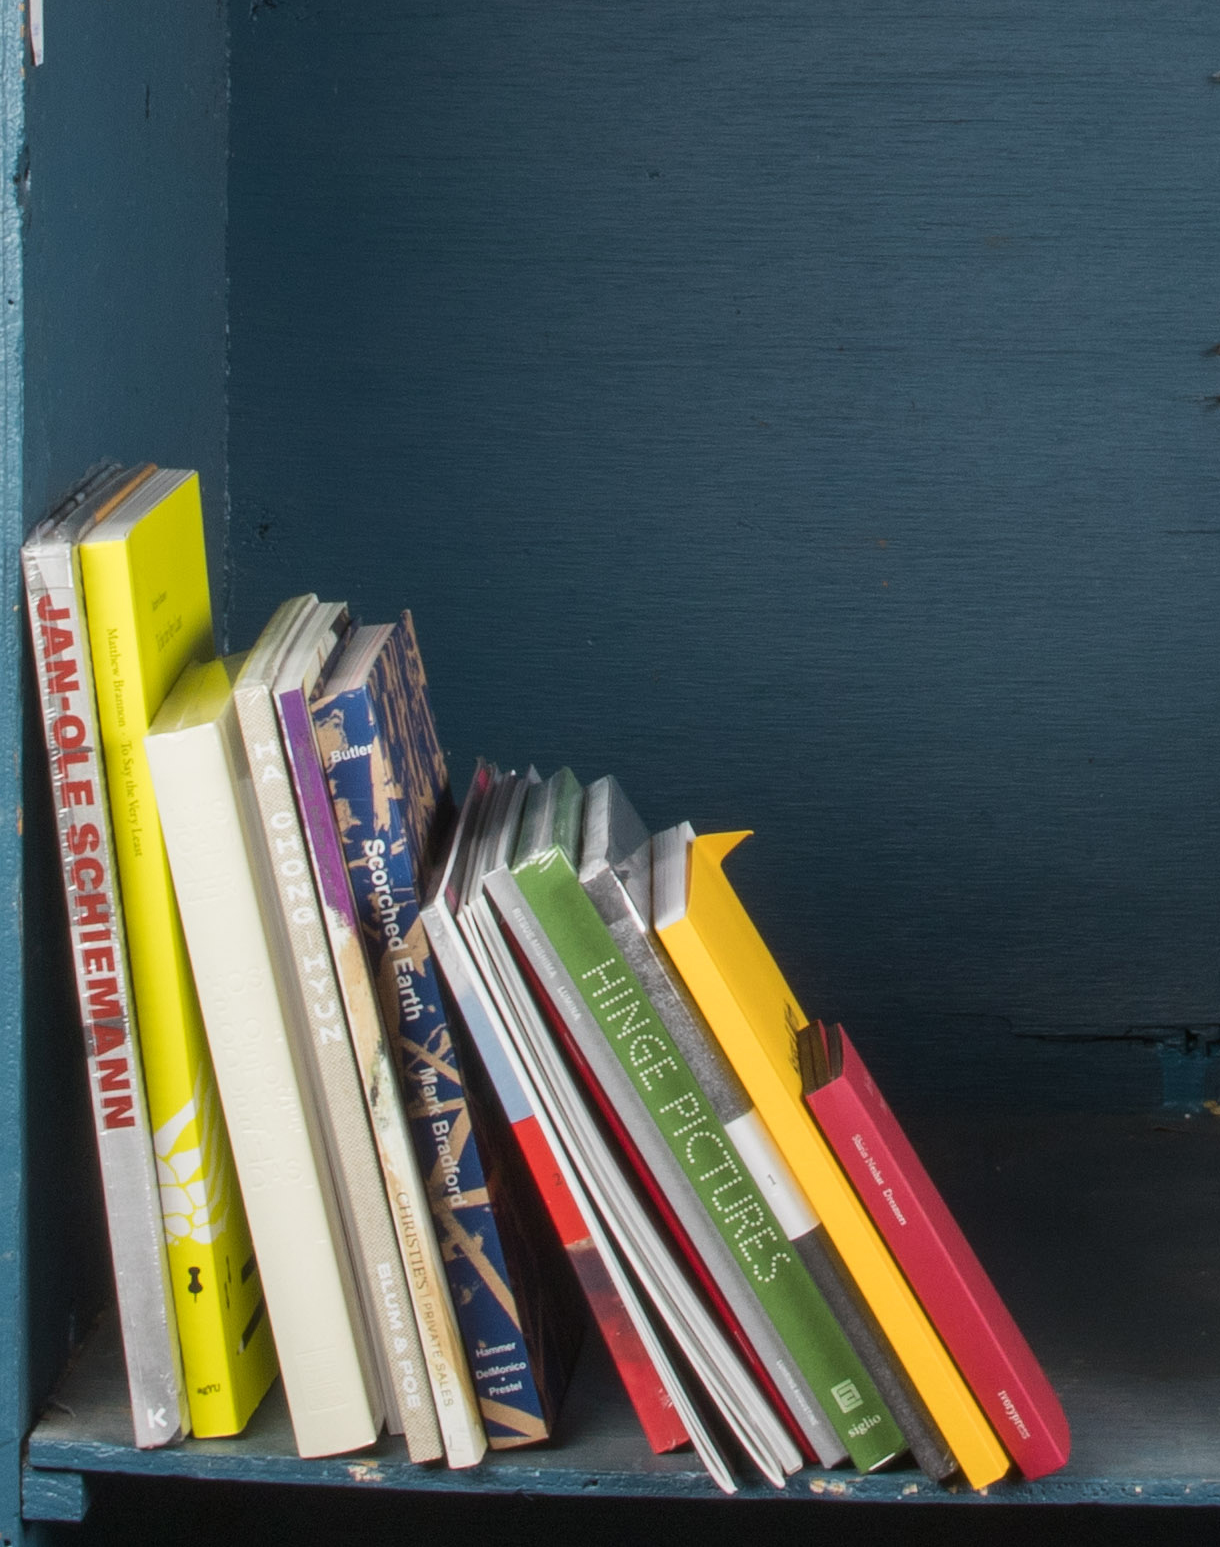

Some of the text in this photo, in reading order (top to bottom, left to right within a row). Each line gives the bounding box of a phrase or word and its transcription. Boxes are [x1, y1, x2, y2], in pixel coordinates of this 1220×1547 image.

[330, 744, 373, 763] Butler
[34, 592, 138, 1131] JAN-OLE SCHIEMANN
[362, 836, 425, 1021] Scorched Earth
[580, 955, 794, 1289] HINGE PICTURES
[417, 1065, 468, 1209] Mark Bradford
[475, 1342, 516, 1358] Hammer
[476, 1362, 526, 1380] DelMonico
[489, 1381, 522, 1396] Prestel
[848, 1414, 881, 1438] siglio
